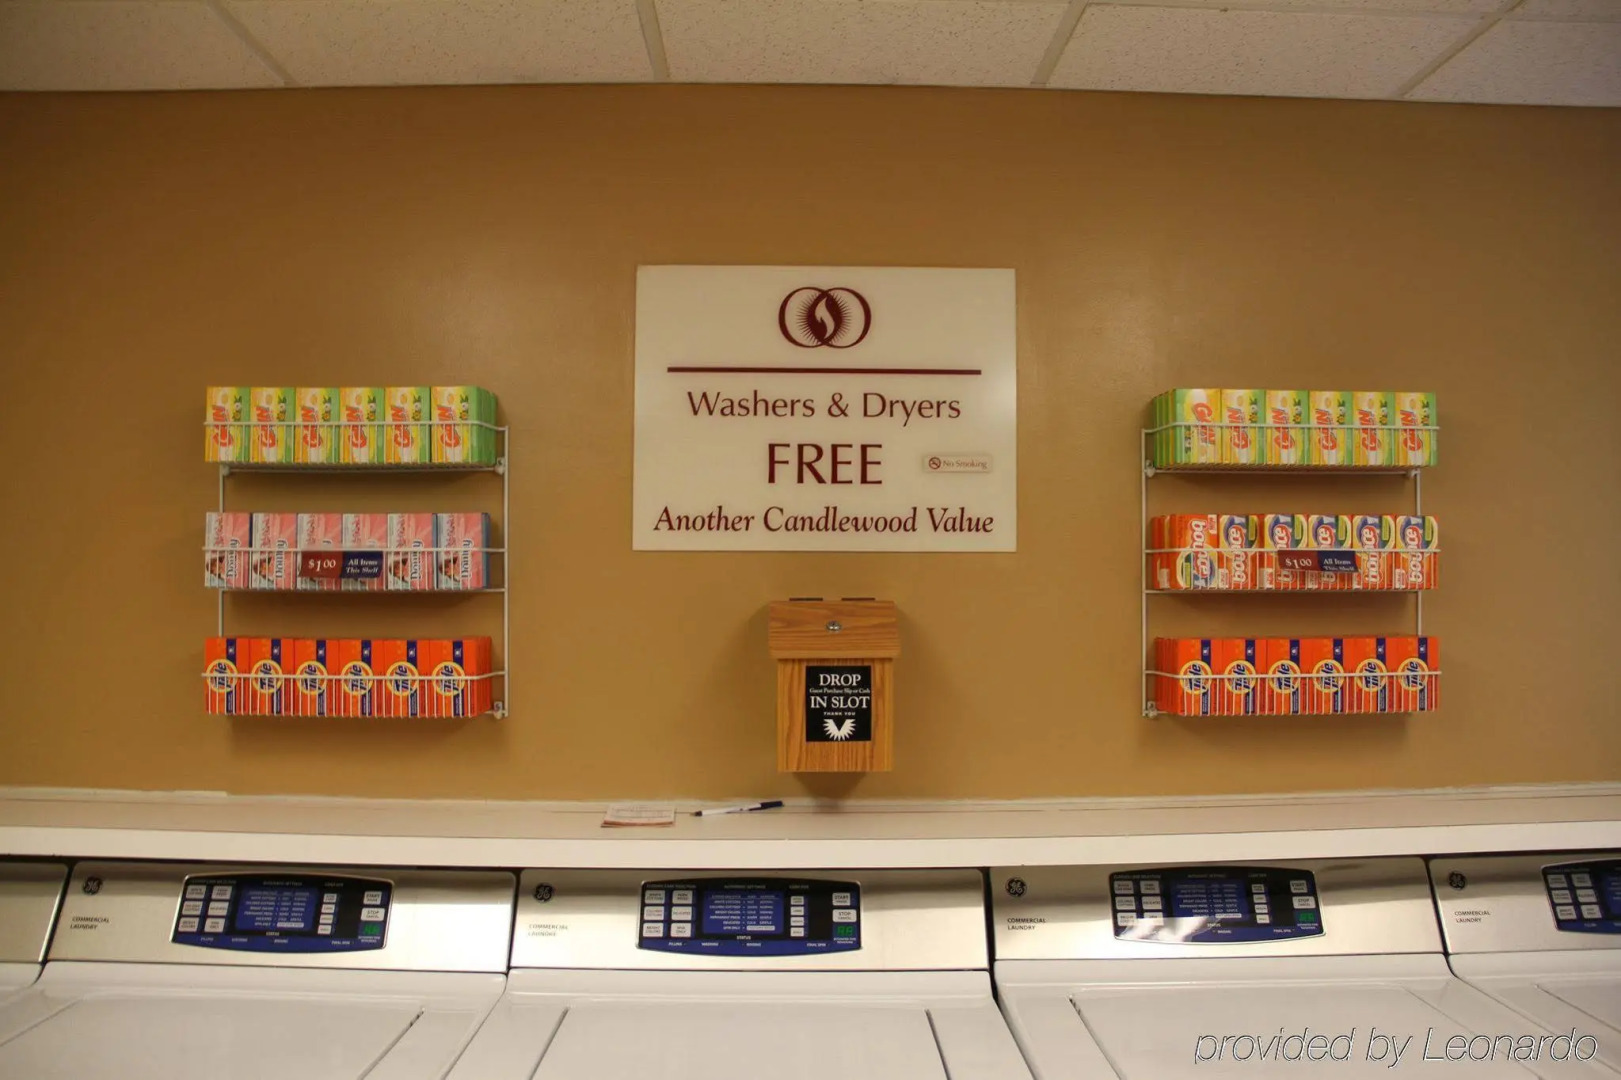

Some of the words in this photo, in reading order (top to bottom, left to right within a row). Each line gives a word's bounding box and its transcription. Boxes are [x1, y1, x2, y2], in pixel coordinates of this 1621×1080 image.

[687, 389, 815, 418] Washers
[827, 391, 849, 418] &
[863, 391, 961, 427] Dryers
[767, 443, 883, 485] FREE
[943, 459, 954, 467] No
[956, 459, 988, 470] Smoking
[653, 505, 755, 532] Another
[763, 505, 918, 533] Candlewood
[927, 506, 994, 533] Value
[348, 558, 358, 566] All
[360, 558, 378, 566] Items
[819, 673, 861, 686] DROP
[810, 695, 828, 708] IN
[831, 695, 870, 709] SLOT
